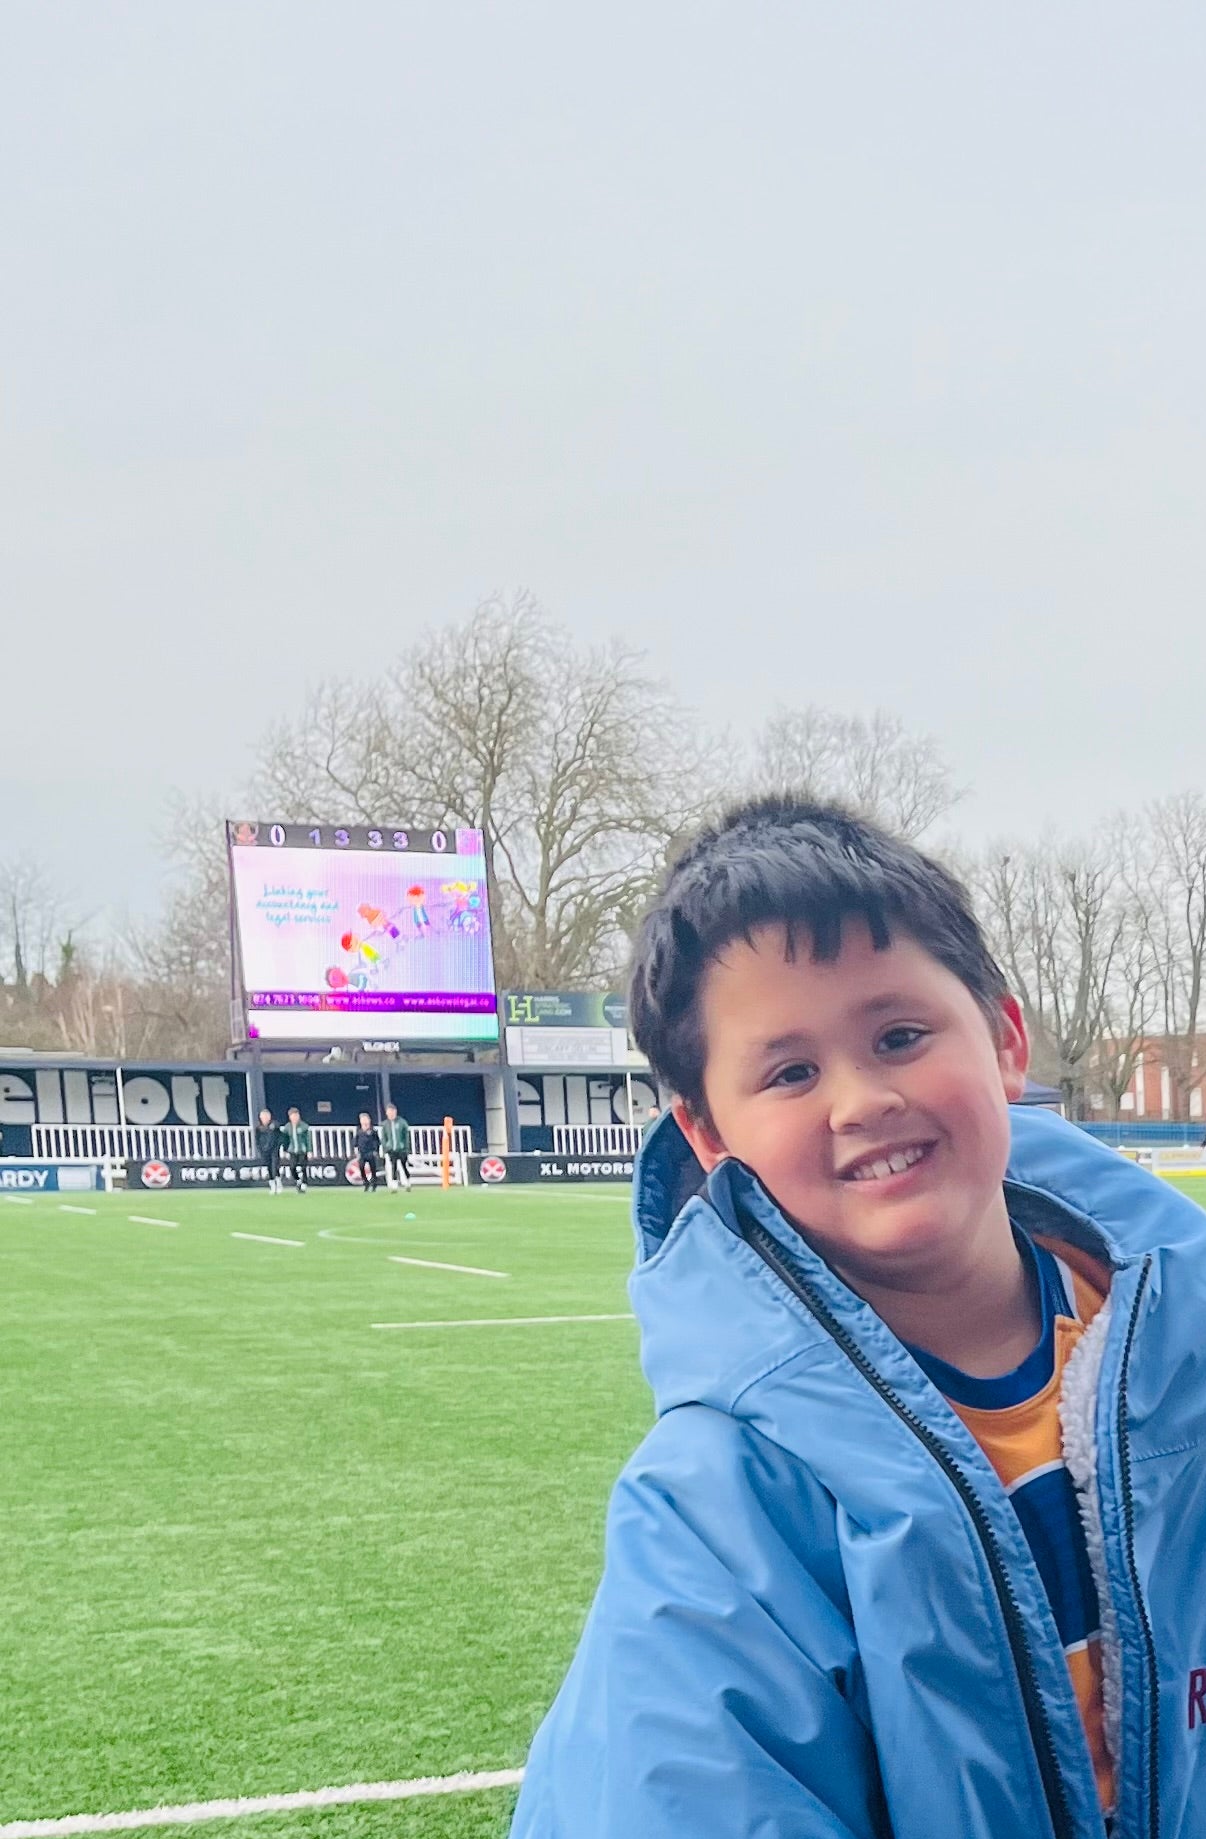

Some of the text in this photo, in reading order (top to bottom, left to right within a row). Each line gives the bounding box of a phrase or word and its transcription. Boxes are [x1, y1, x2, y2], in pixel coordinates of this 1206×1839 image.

[517, 1075, 666, 1125] ellio
[181, 1166, 220, 1181] MOT
[222, 1166, 236, 1181] &
[540, 1162, 634, 1176] XL MOTORS
[0, 1169, 49, 1188] RDY
